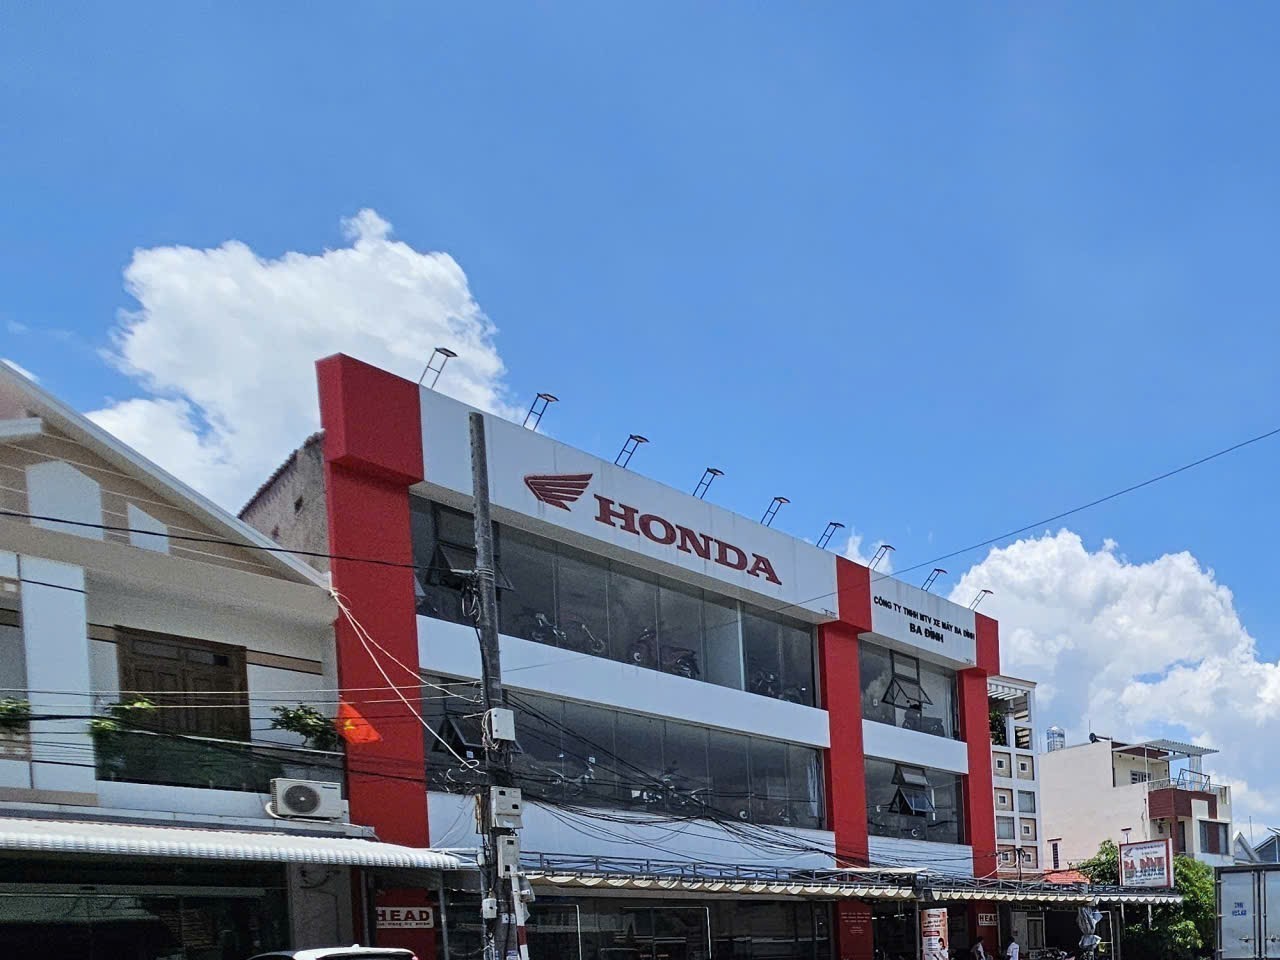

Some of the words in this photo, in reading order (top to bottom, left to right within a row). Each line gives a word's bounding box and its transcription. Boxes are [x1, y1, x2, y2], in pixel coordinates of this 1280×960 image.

[593, 493, 783, 586] HONDA
[873, 595, 892, 610] CÔNG
[893, 602, 902, 614] TY
[902, 606, 919, 620] TNHH
[954, 625, 962, 636] BA
[909, 622, 922, 636] BA
[924, 626, 945, 643] ĐÌNH
[376, 910, 430, 922] HEAD
